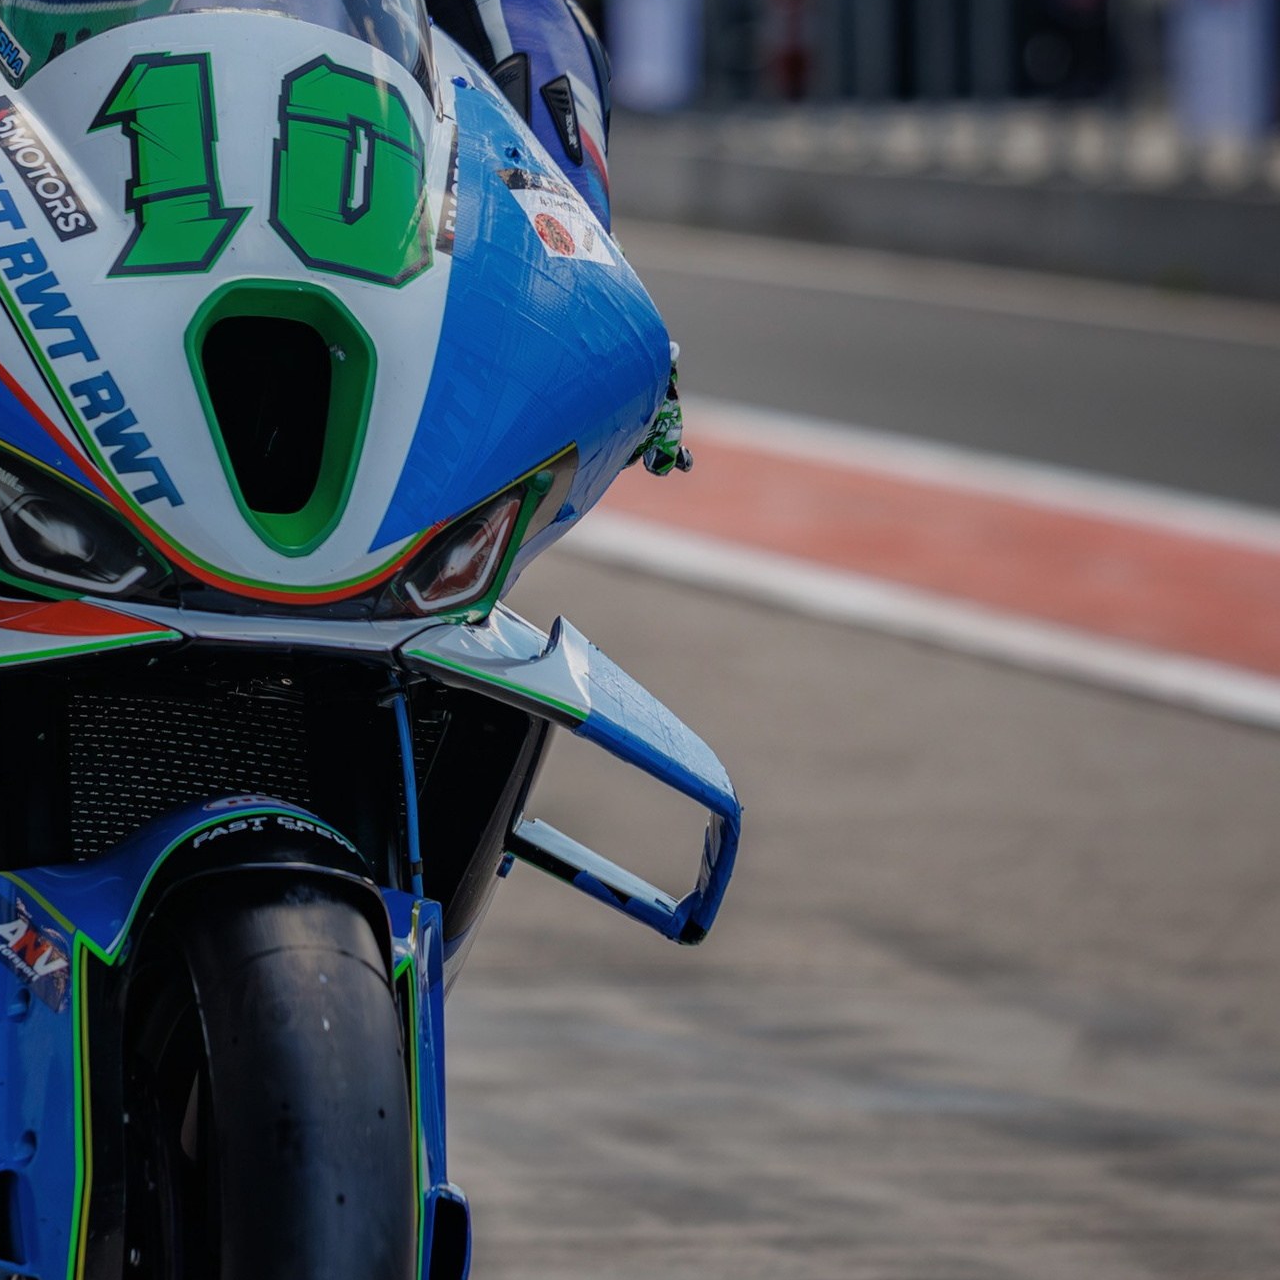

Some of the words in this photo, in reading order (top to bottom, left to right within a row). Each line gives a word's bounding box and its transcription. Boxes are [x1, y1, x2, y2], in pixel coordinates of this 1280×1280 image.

[87, 52, 434, 289] 10
[72, 371, 185, 507] RWT
[193, 816, 268, 849] FAST
[277, 816, 357, 853] CREW
